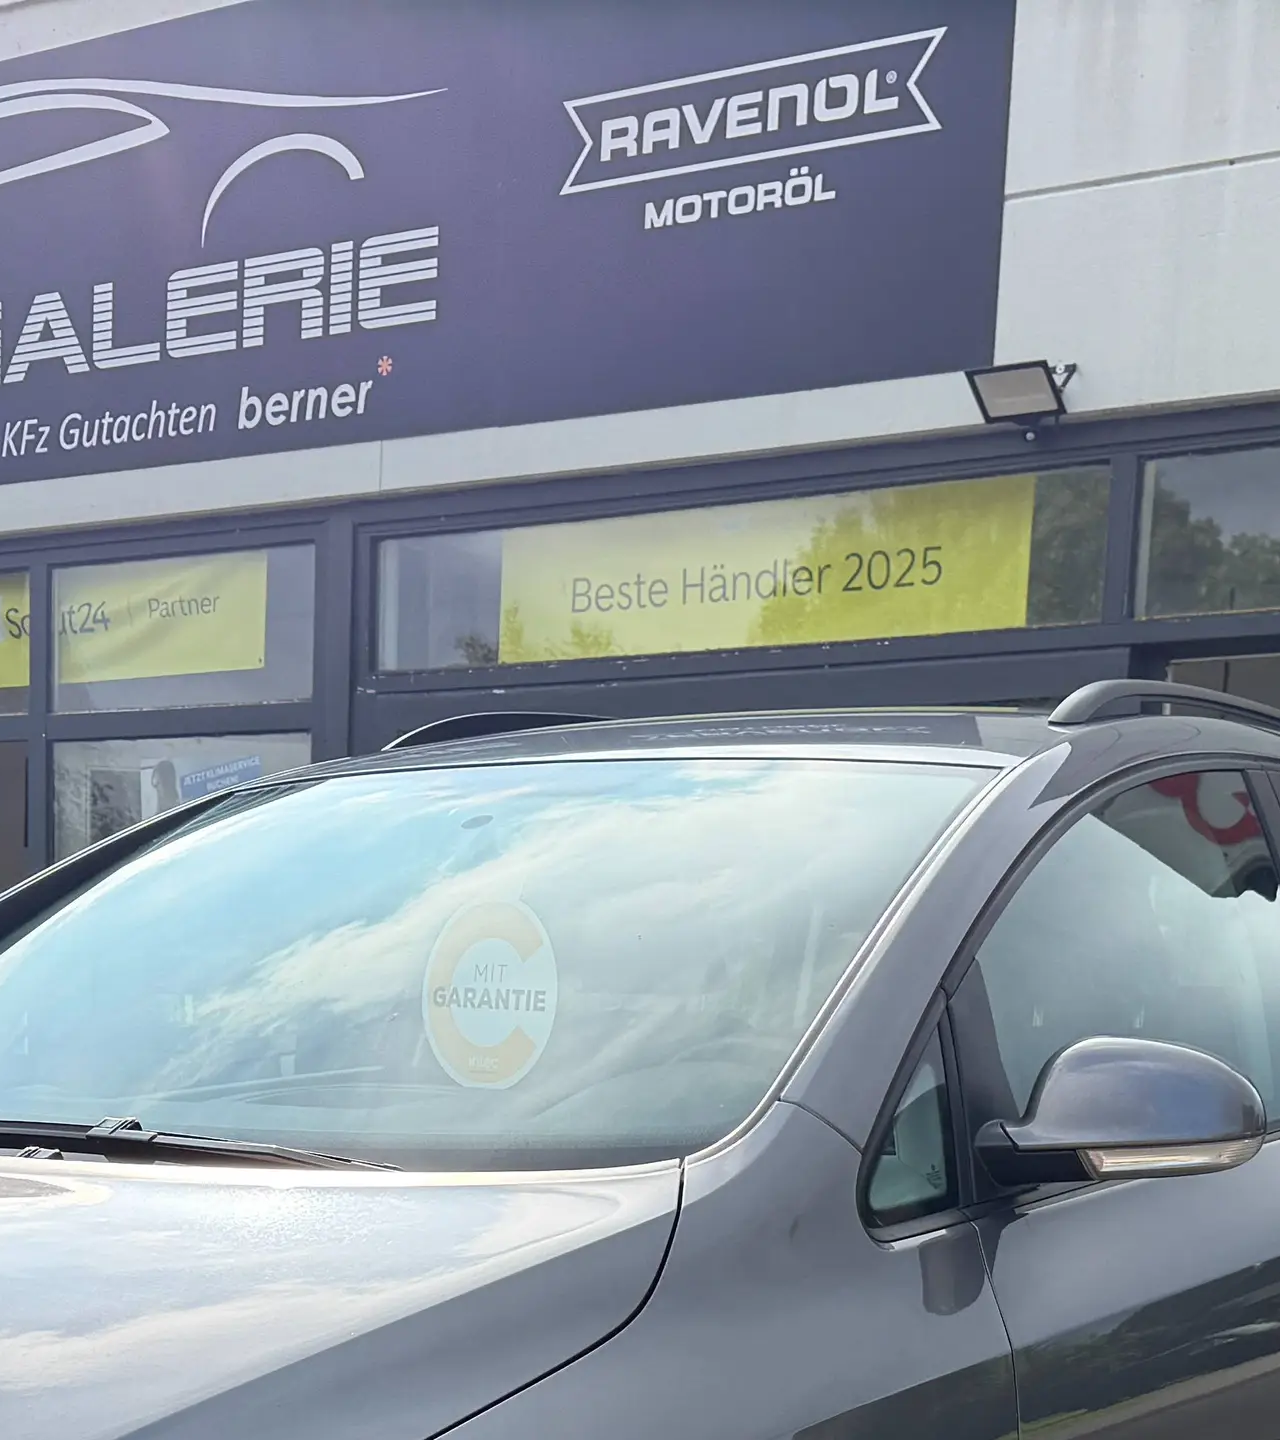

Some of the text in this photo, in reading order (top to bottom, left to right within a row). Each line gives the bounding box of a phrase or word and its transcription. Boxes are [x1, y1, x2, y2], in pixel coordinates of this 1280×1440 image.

[644, 166, 836, 230] MOTORÖL
[59, 400, 216, 450] Gutachten
[237, 386, 373, 430] berner
[570, 546, 943, 613] Beste Händler 2025
[5, 601, 111, 640] Scut24
[148, 594, 221, 618] Partner
[432, 986, 547, 1011] GARANTIE
[474, 964, 508, 983] MIT
